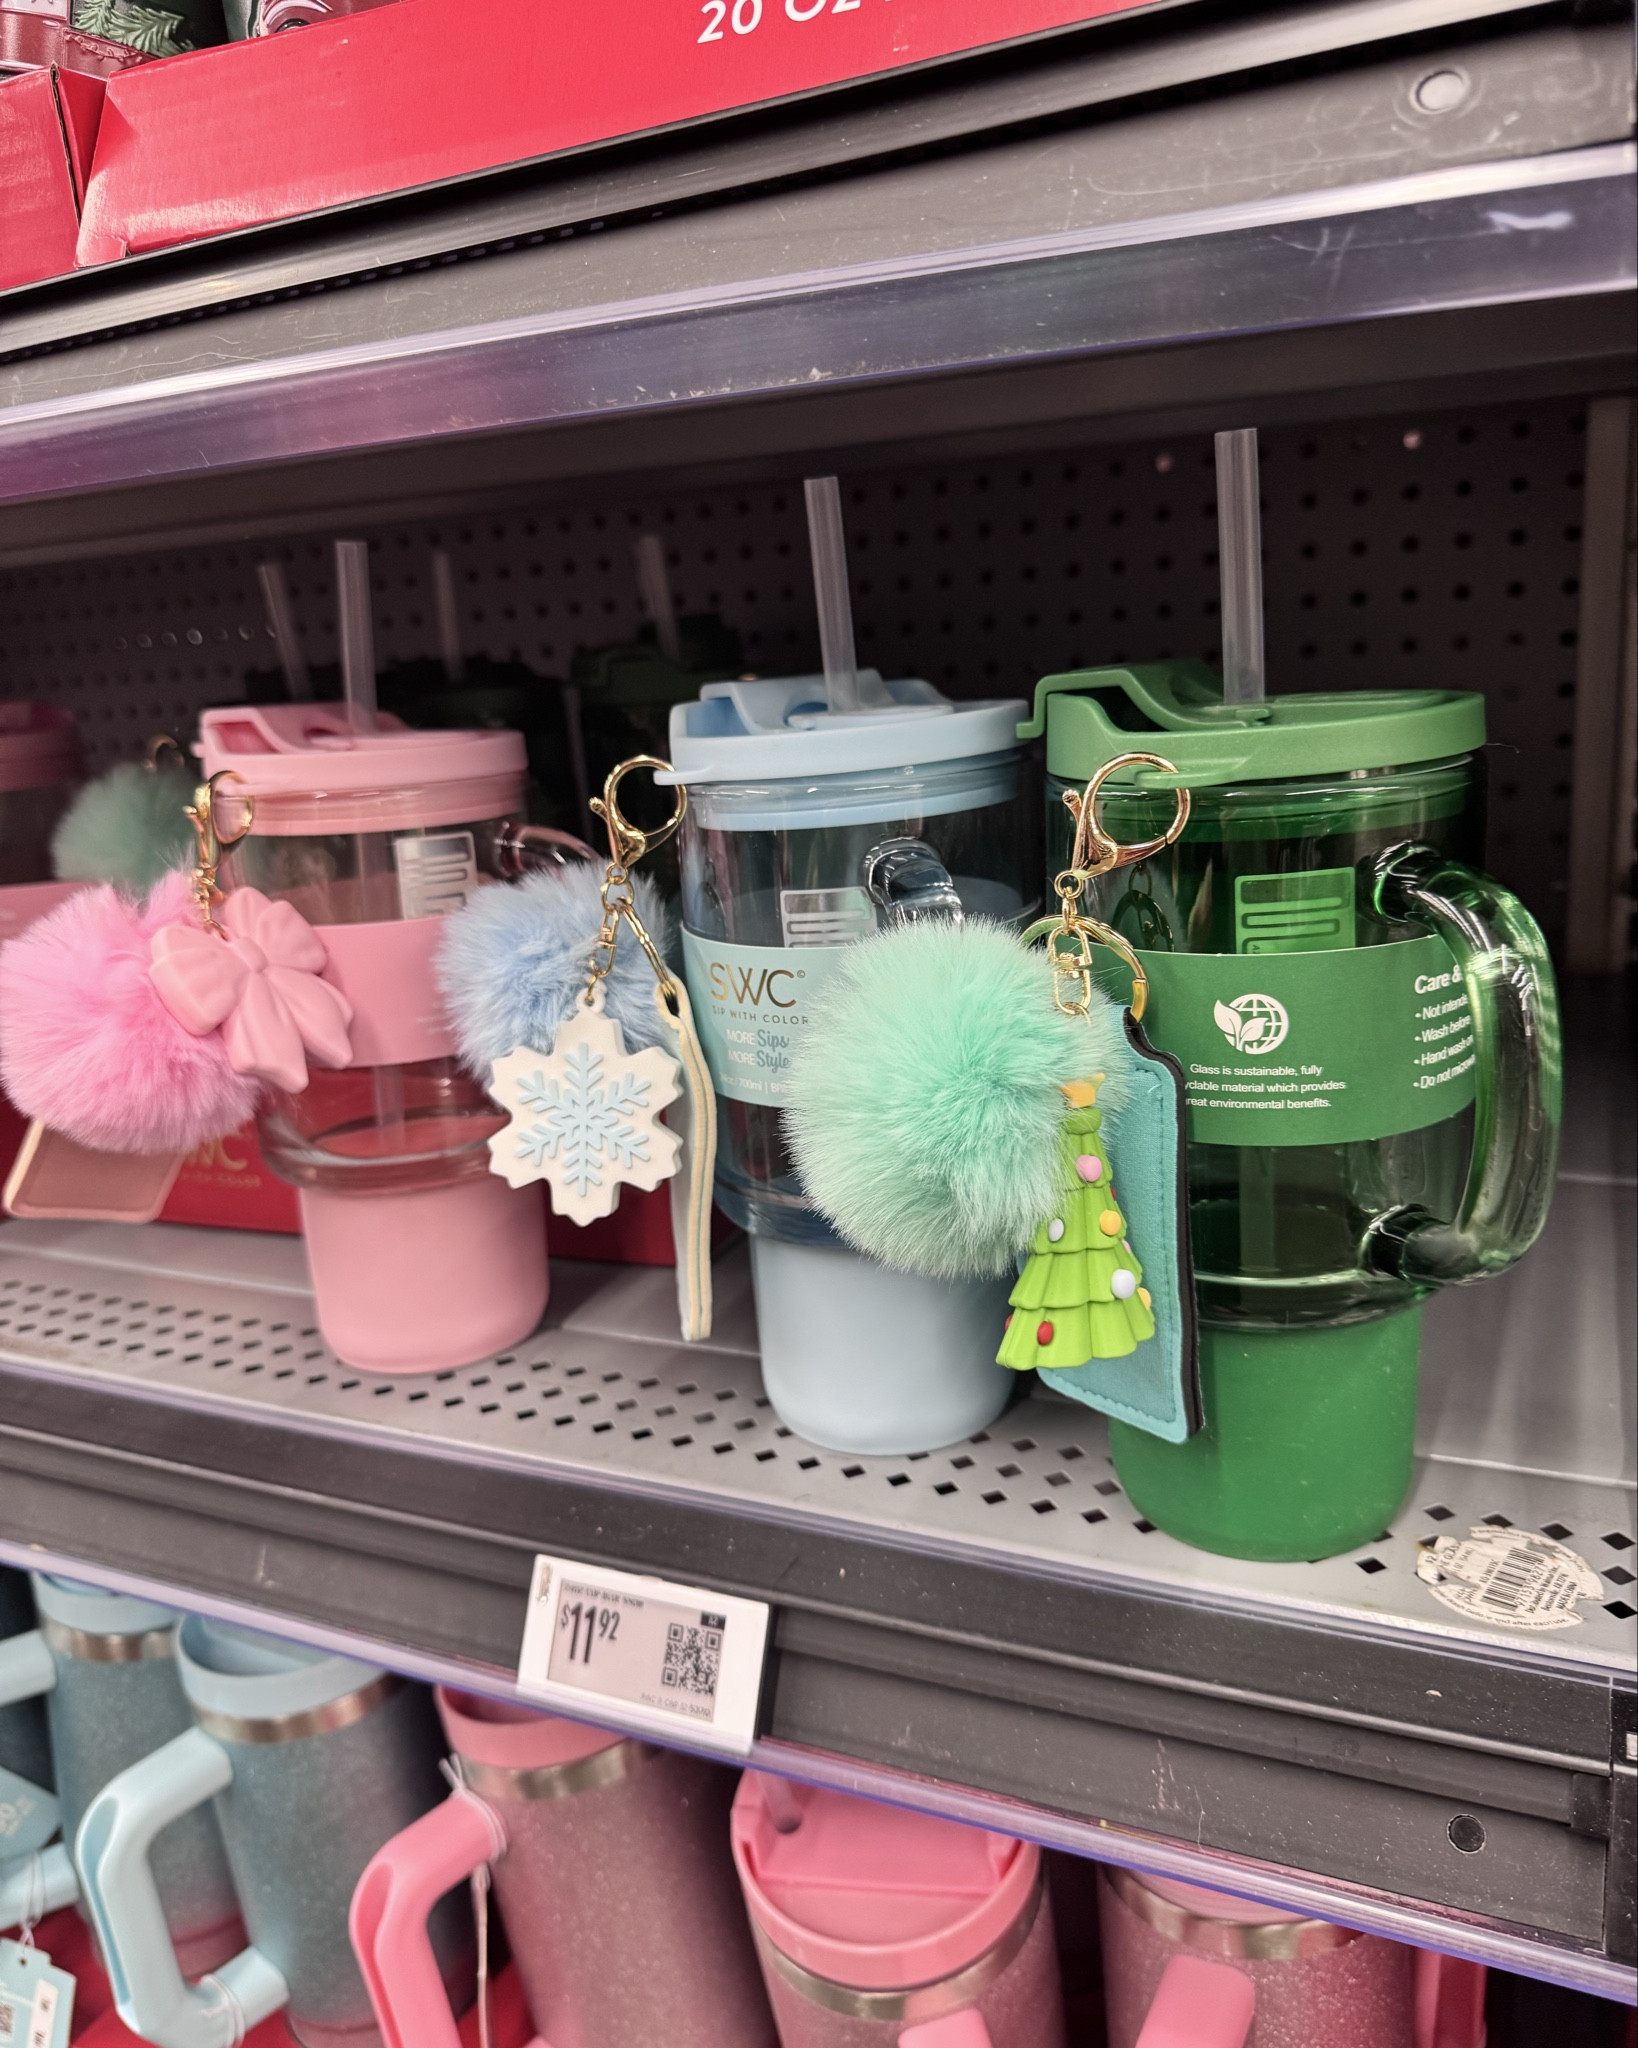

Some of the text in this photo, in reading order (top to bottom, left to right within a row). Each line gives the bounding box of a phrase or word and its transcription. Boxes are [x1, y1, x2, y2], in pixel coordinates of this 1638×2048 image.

[697, 0, 763, 43] 20
[1414, 973, 1451, 995] Care
[729, 1008, 757, 1021] WITH
[762, 1013, 809, 1025] COLOR
[1422, 1003, 1441, 1020] Not
[726, 1028, 790, 1052] MORE Sips
[1422, 1025, 1449, 1042] Wash
[728, 1049, 756, 1066] MORE
[1421, 1046, 1447, 1066] Hand
[1189, 1063, 1323, 1077] Glass is sustainable, fully
[1420, 1075, 1436, 1089] Do
[1436, 1068, 1452, 1083] not
[1221, 1083, 1265, 1093] material
[1266, 1083, 1298, 1093] which
[1300, 1080, 1346, 1094] provides
[1209, 1099, 1285, 1109] environmental
[1287, 1097, 1332, 1109] benefits.
